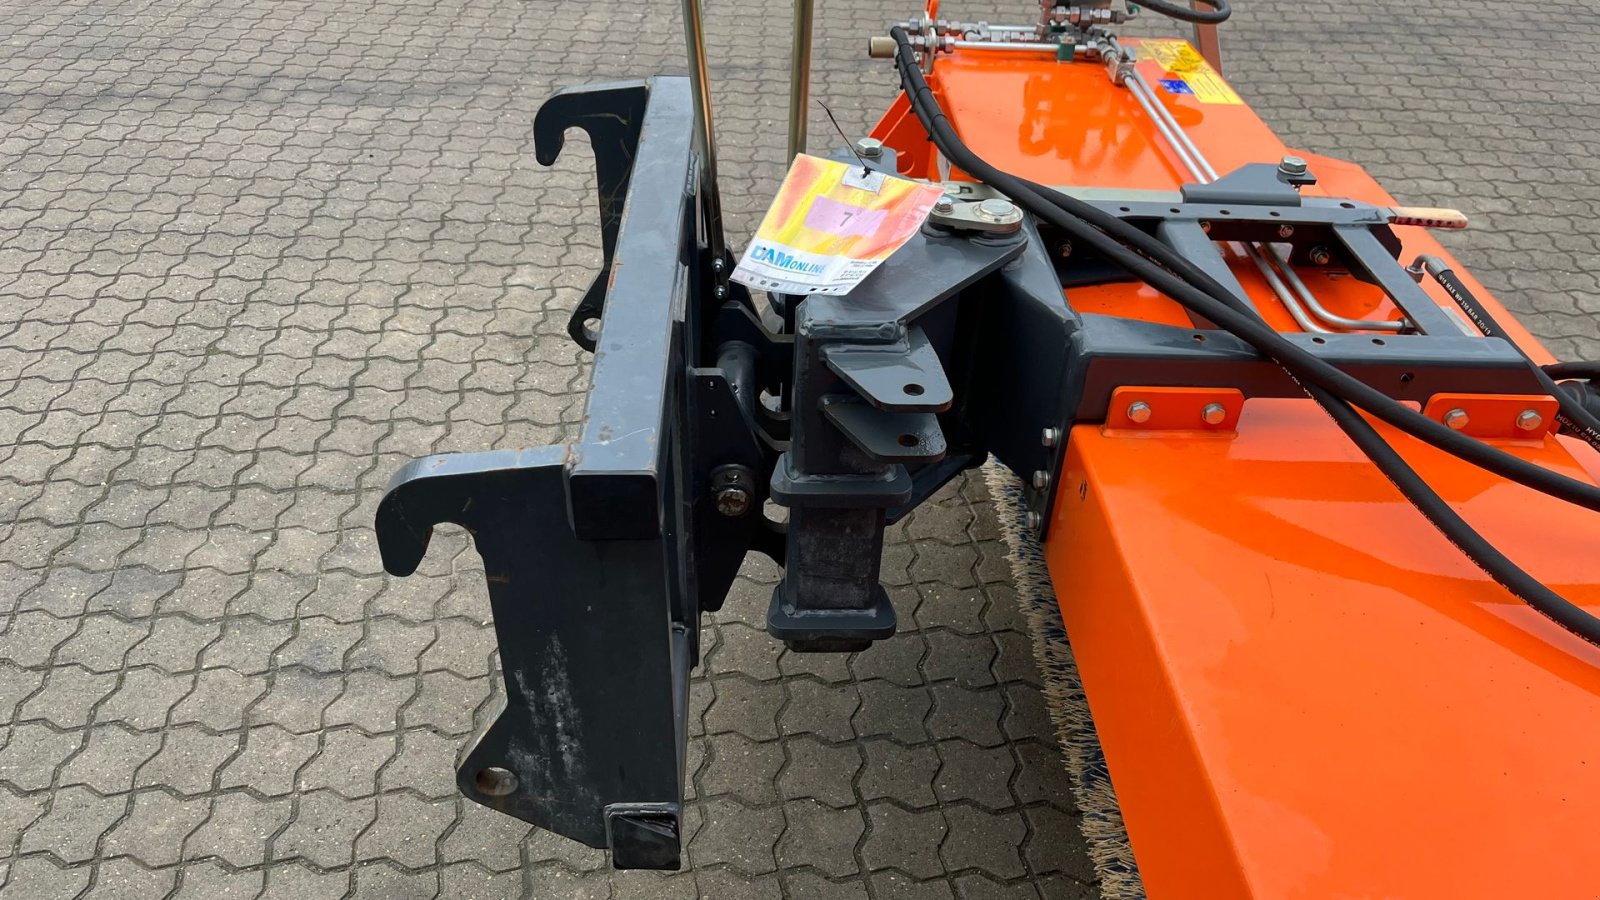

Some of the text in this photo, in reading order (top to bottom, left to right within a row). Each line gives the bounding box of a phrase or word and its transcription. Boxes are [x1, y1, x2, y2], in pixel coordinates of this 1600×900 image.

[839, 212, 854, 228] 7
[1446, 282, 1456, 294] MAX
[1467, 308, 1478, 320] BAR
